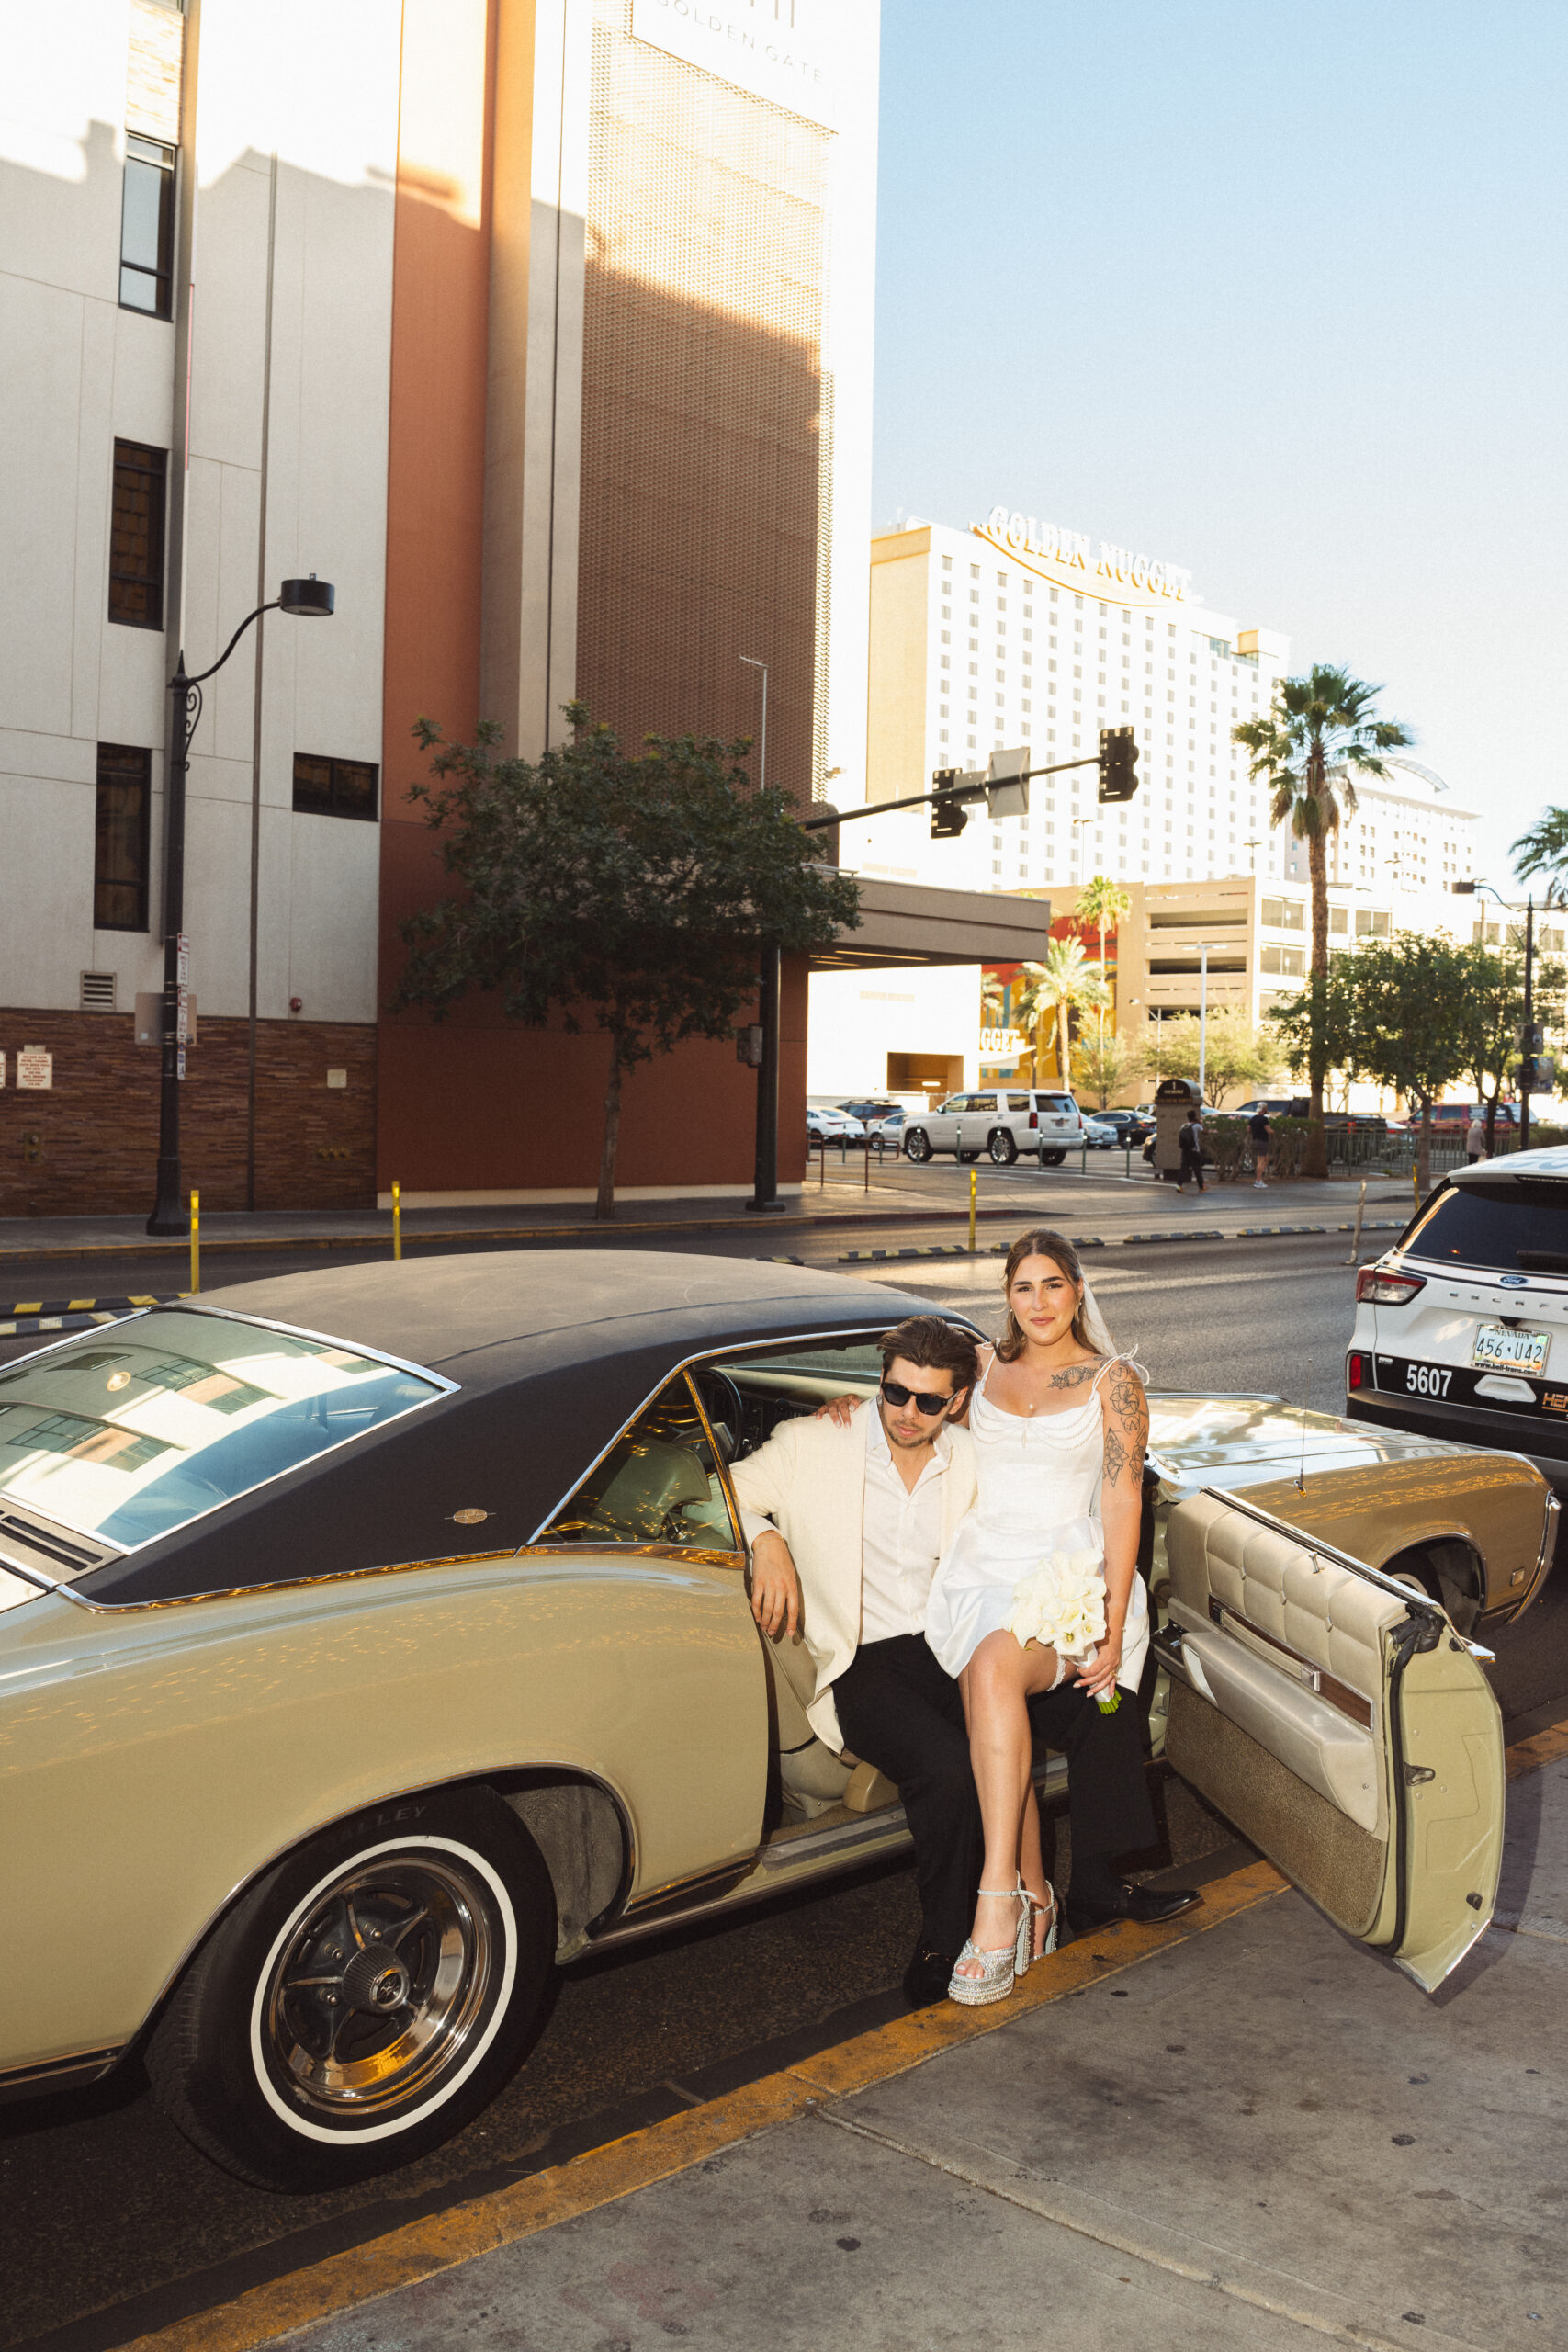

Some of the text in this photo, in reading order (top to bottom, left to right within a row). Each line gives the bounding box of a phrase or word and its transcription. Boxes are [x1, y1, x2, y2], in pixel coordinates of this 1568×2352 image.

[765, 45, 823, 85] GATE
[987, 505, 1193, 602] GOLDEN NUGGET
[1502, 1276, 1522, 1284] Ford
[1495, 1329, 1530, 1340] NEVADA
[1406, 1363, 1453, 1397] 5607
